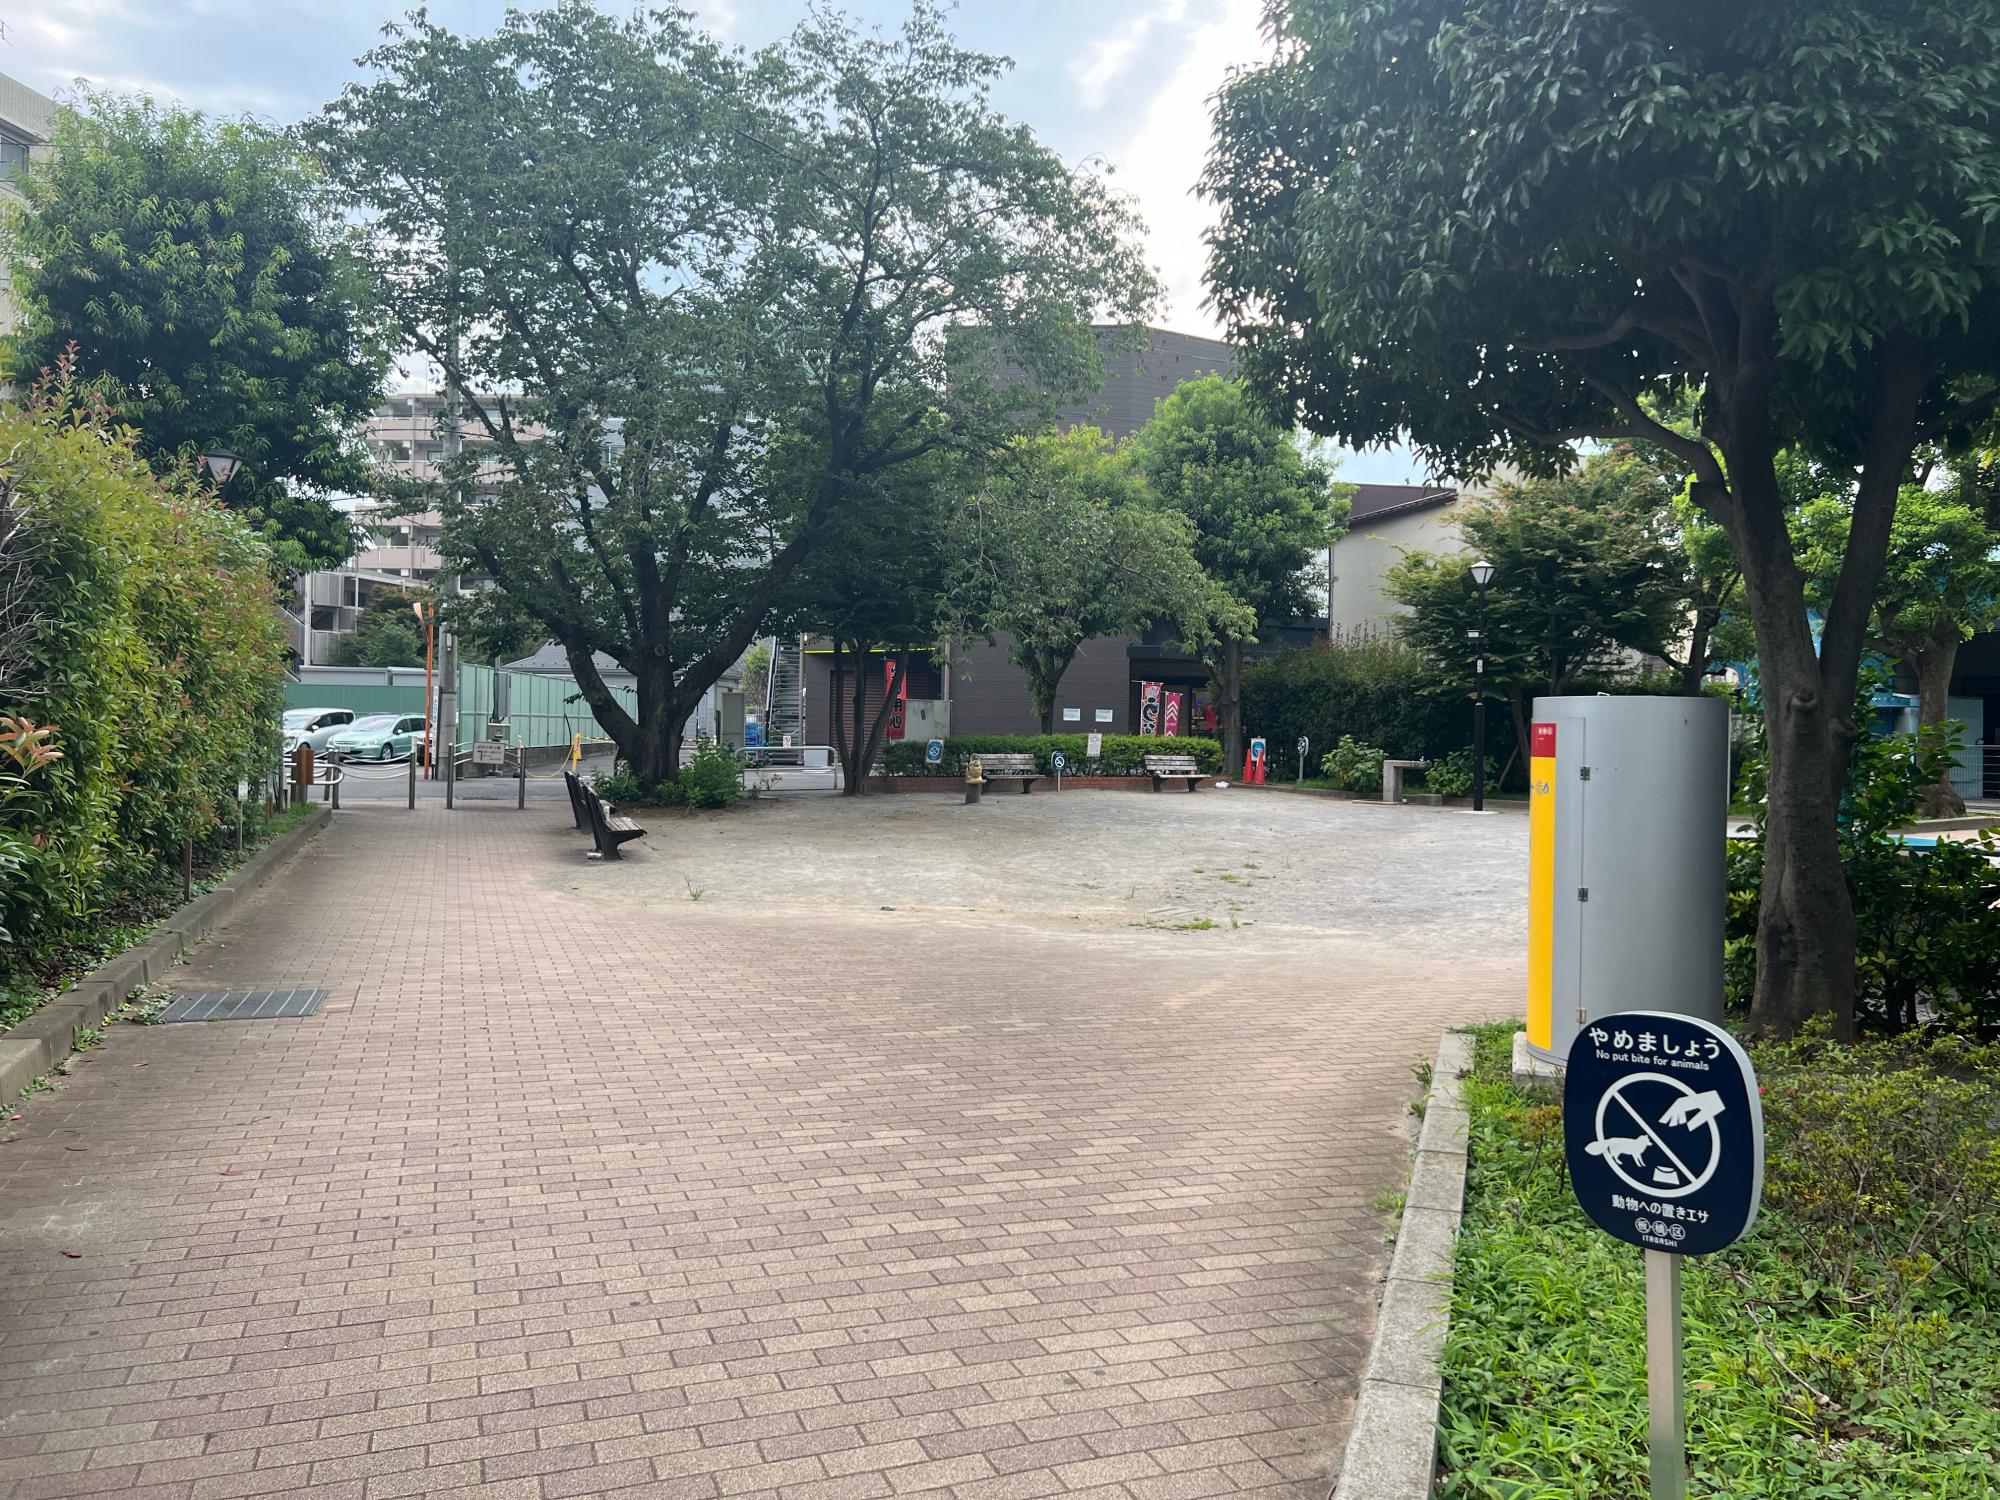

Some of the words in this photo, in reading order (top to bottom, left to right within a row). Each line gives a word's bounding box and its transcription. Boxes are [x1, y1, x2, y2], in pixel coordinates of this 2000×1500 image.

[1588, 1026, 1721, 1060] やめましょう
[1596, 1049, 1610, 1060] No
[1612, 1053, 1629, 1063] put
[1631, 1054, 1651, 1064] bite
[1653, 1056, 1668, 1066] for
[1671, 1059, 1710, 1071] animals
[1611, 1194, 1710, 1224] 動物への置きエサ
[1642, 1234, 1678, 1248] ITABASHI
